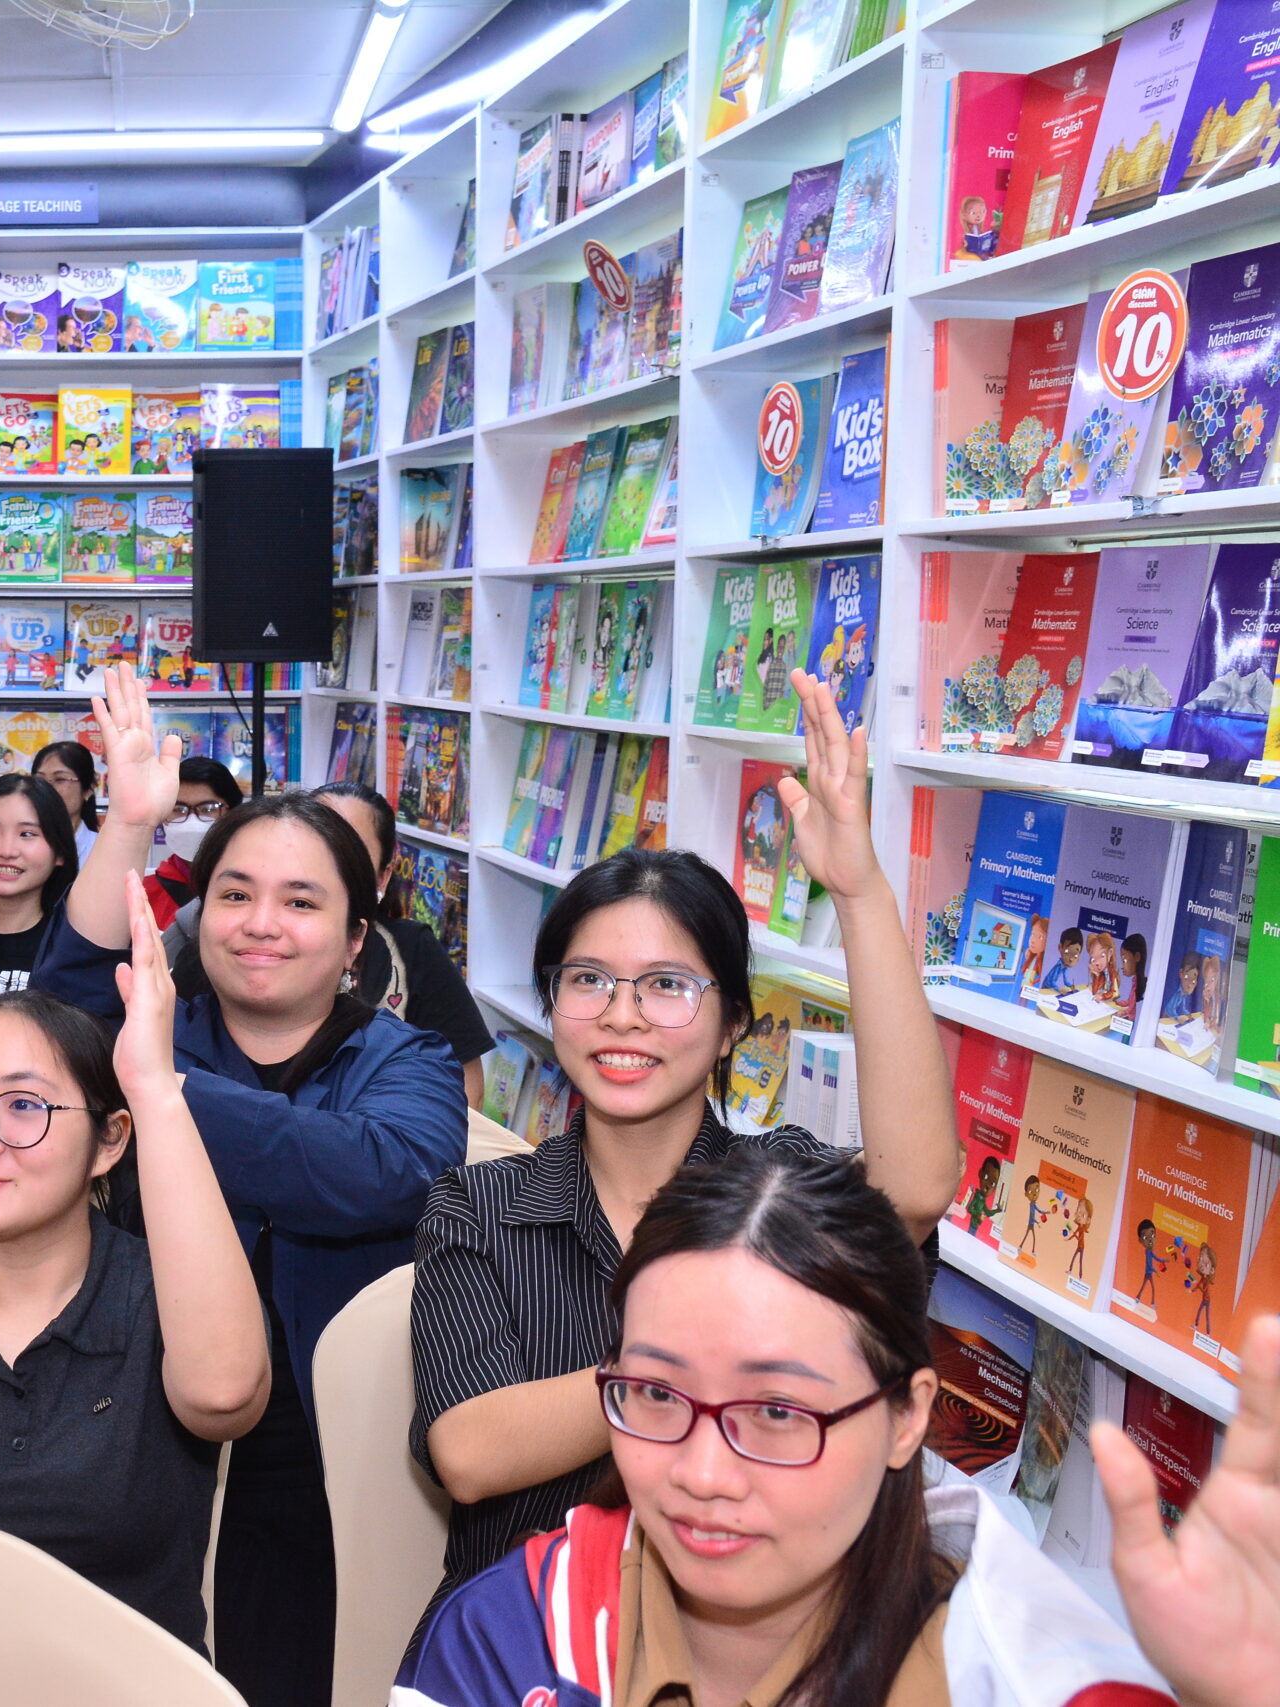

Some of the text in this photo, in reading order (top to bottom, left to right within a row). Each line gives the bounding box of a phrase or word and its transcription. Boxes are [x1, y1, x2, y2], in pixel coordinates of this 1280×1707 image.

[1144, 76, 1178, 98] English
[1052, 119, 1083, 139] English
[23, 200, 82, 213] TEACHING
[73, 267, 114, 280] Speak
[141, 265, 183, 277] Speak
[788, 260, 819, 275] POWER
[4, 273, 45, 285] Speak
[217, 270, 248, 284] First
[596, 262, 624, 301] 10
[210, 282, 254, 296] Friends
[1128, 300, 1157, 308] discount
[1209, 312, 1275, 331] Cambridge Lower Secondary
[1113, 312, 1172, 378] 10
[1208, 325, 1271, 348] Mathematics
[1029, 373, 1074, 389] Mathematic
[3, 413, 27, 427] GO
[73, 410, 100, 426] GO
[145, 413, 172, 428] GO
[834, 402, 884, 450] Kid's
[763, 410, 795, 461] 10
[0, 500, 40, 516] Family
[74, 500, 114, 517] Family
[147, 499, 187, 517] Family
[0, 513, 40, 527] Friends
[73, 514, 115, 528] Friends
[146, 513, 188, 527] Friends
[724, 576, 754, 605] Kid's
[767, 571, 795, 603] Kid's
[830, 566, 860, 600] Kid's
[11, 623, 44, 641] UP
[87, 619, 119, 636] UP
[1032, 618, 1077, 630] Mathematics
[1126, 617, 1159, 630] Science
[1241, 618, 1280, 633] Science
[159, 624, 192, 642] UP
[1006, 851, 1043, 866] CAMBRIDGE
[979, 857, 1056, 885] Primary Mathemat
[1091, 870, 1129, 886] CAMBRIDGE
[1064, 880, 1151, 910] Primary Mathematics
[1209, 888, 1233, 903] CAMBRIDGE
[1187, 900, 1213, 921] Primary
[981, 1085, 1012, 1106] CAMBRIDGE
[959, 1090, 1022, 1129] Primary Mathemat
[1053, 1125, 1090, 1147] CAMBRIDGE
[1028, 1128, 1058, 1154] Primary
[1059, 1144, 1112, 1175] Mathematics
[1166, 1165, 1208, 1190] CAMBRIDGE
[1137, 1168, 1172, 1197] Primary
[1173, 1184, 1234, 1221] Mathematics
[978, 1366, 1022, 1398] Mechanics
[984, 1388, 1020, 1413] Coursebook
[1126, 1424, 1148, 1451] Global
[1150, 1443, 1200, 1489] Perspectives
